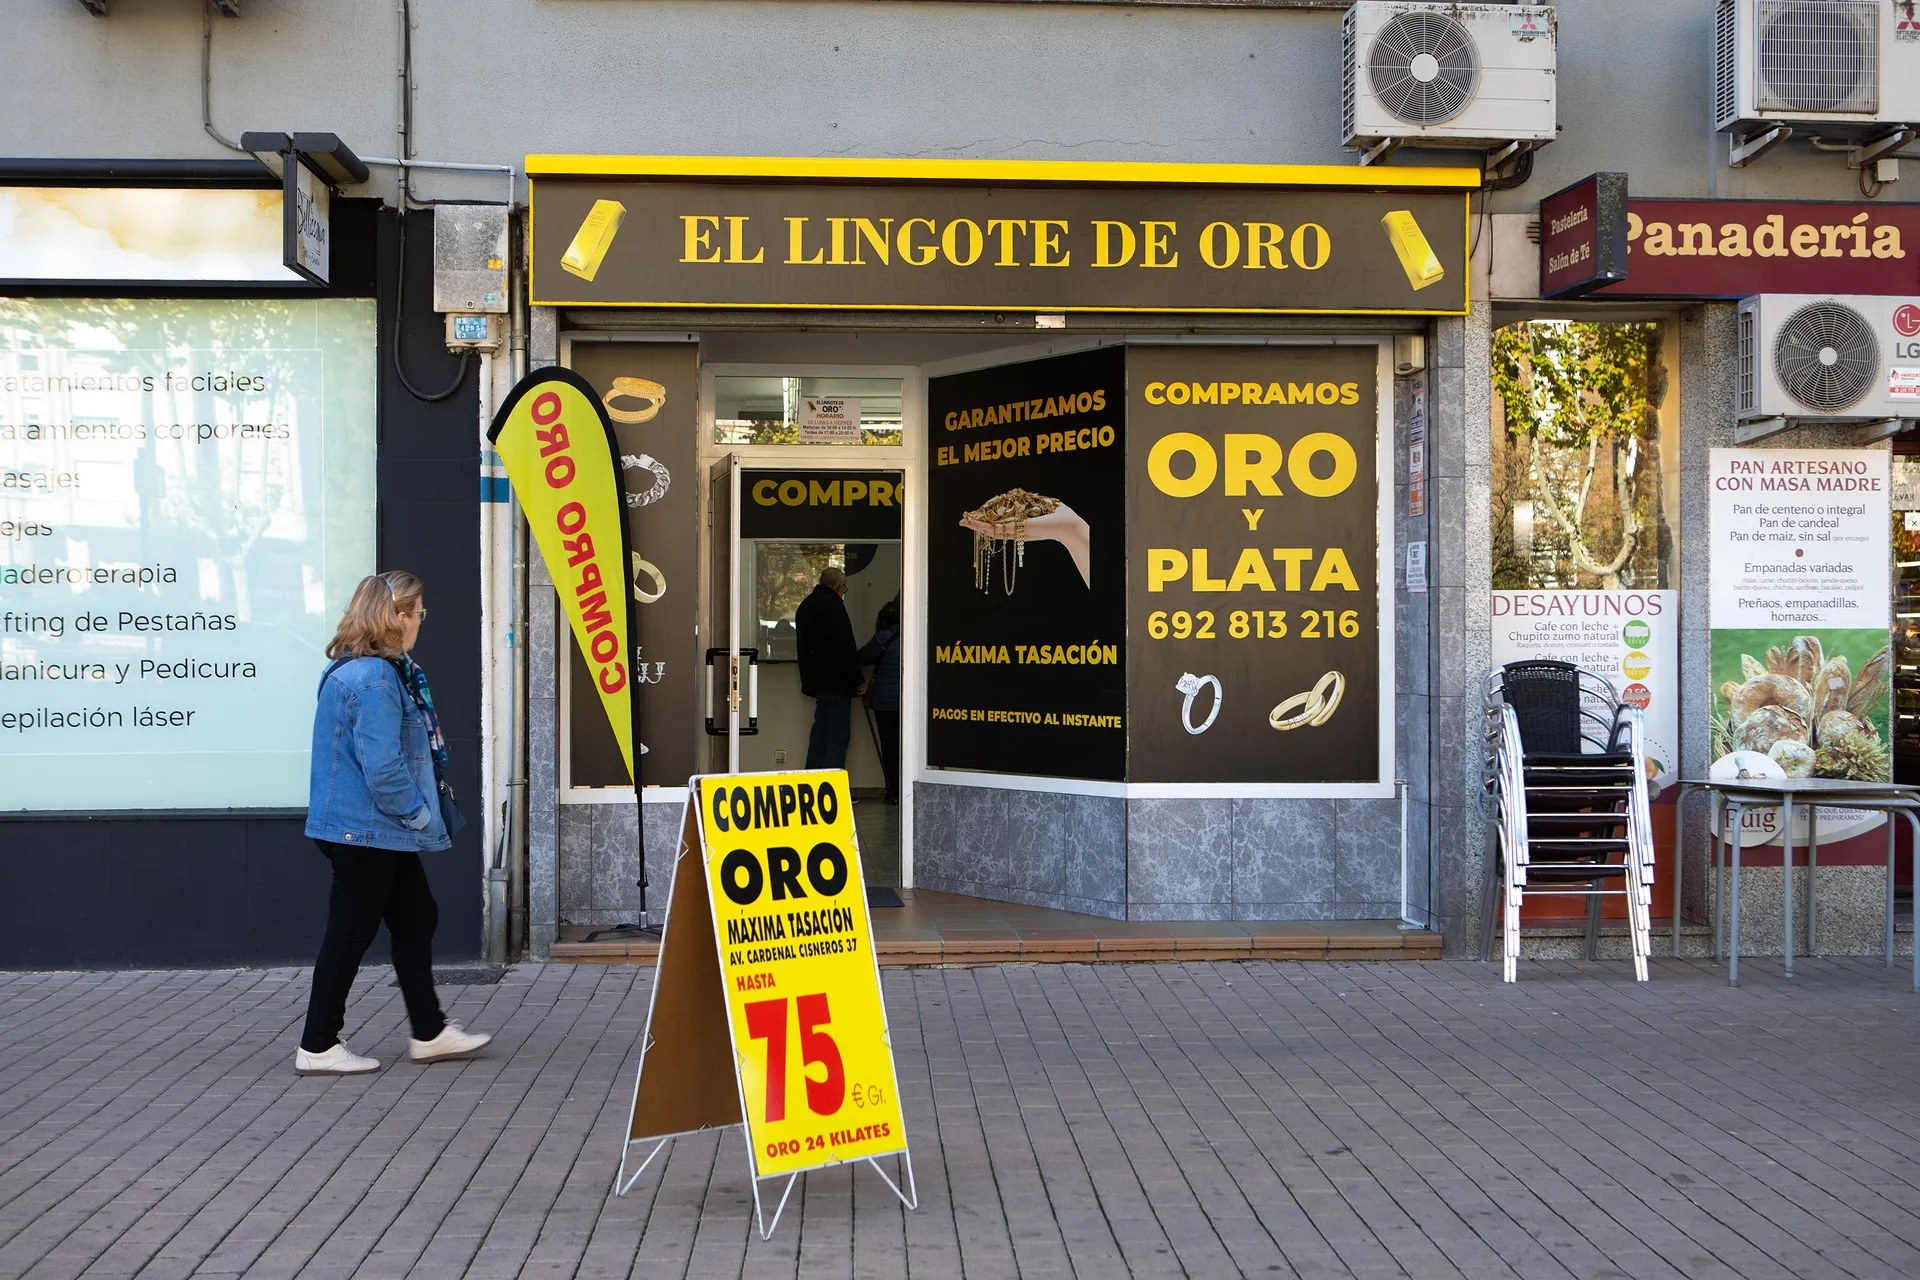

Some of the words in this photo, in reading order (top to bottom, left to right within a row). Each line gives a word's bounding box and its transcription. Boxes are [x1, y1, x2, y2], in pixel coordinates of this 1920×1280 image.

[1551, 204, 1588, 236] Pastelería
[679, 216, 764, 263] EL
[784, 216, 1071, 266] LINGOTE
[1091, 220, 1178, 268] DE
[1199, 221, 1331, 270] ORO
[1549, 252, 1570, 274] Salón
[1570, 248, 1579, 264] de
[1580, 241, 1590, 260] Té
[1896, 342, 1920, 358] LG
[0, 372, 155, 392] atamientos
[166, 371, 266, 392] faciales
[1144, 382, 1360, 405] COMPRAMOS
[945, 390, 1106, 432] GARANTIZAMOS
[0, 420, 147, 440] atamientos
[154, 419, 291, 444] corporales
[938, 446, 959, 466] EL
[964, 436, 1030, 463] MEJOR
[1037, 425, 1115, 454] PRECIO
[1147, 432, 1357, 498] ORO
[1730, 461, 1764, 474] PAN
[1771, 461, 1867, 475] ARTESANO
[1716, 477, 1753, 491] CON
[1760, 478, 1810, 491] MASA
[1816, 478, 1881, 491] MADRE
[1241, 509, 1265, 530] Y
[1733, 504, 1752, 514] Pan
[1755, 504, 1769, 514] de
[1772, 505, 1814, 514] centeno
[1826, 504, 1866, 516] integral
[1760, 518, 1778, 528] Pan
[1782, 517, 1796, 528] de
[1798, 517, 1839, 528] candeal
[1730, 531, 1749, 541] Pan
[1752, 531, 1766, 541] de
[1799, 532, 1814, 541] sin
[1816, 531, 1831, 541] sal
[0, 563, 177, 588] aderoterapia
[1148, 548, 1360, 592] PLATA
[1744, 562, 1807, 574] Empanadas
[1809, 563, 1853, 573] variadas
[1492, 594, 1662, 616] DESAYUNOS
[1738, 598, 1783, 609] Preñaos,
[1785, 598, 1859, 610] empanadillas,
[0, 612, 65, 637] fting
[75, 611, 108, 632] de
[118, 612, 237, 632] Pestañas
[1148, 610, 1216, 640] 692
[1228, 610, 1288, 639] 813
[1301, 609, 1360, 638] 216
[1534, 622, 1558, 631] Cafe
[1582, 622, 1609, 631] leche
[1508, 632, 1551, 643] Chupito
[1584, 632, 1619, 641] natural
[936, 640, 1011, 664] MÁXIMA
[1015, 640, 1117, 665] TASACIÓN
[1582, 653, 1609, 662] leche
[0, 660, 106, 680] anicura
[115, 663, 130, 684] y
[140, 658, 256, 679] Pedicura
[1584, 662, 1619, 672] natural
[2, 707, 122, 733] epilación
[134, 706, 195, 727] láser
[932, 708, 967, 720] PAGOS
[970, 710, 985, 721] EN
[988, 710, 1041, 724] EFECTIVO
[1044, 713, 1059, 725] AL
[1062, 714, 1121, 728] INSTANTE
[713, 781, 838, 832] COMPRO
[721, 842, 848, 905] ORO
[727, 909, 786, 945] MÁXIMA
[788, 900, 854, 938] TASACIÓN
[730, 951, 744, 966] AV.
[747, 945, 796, 964] CARDENAL
[799, 940, 844, 958] CISNEROS
[846, 938, 857, 952] 37
[736, 973, 776, 992] HASTA
[744, 992, 845, 1123] 75
[852, 1083, 865, 1108] €
[868, 1085, 887, 1106] Gr.
[766, 1139, 800, 1158] ORO
[806, 1135, 825, 1151] 24
[830, 1123, 890, 1147] KILATES
